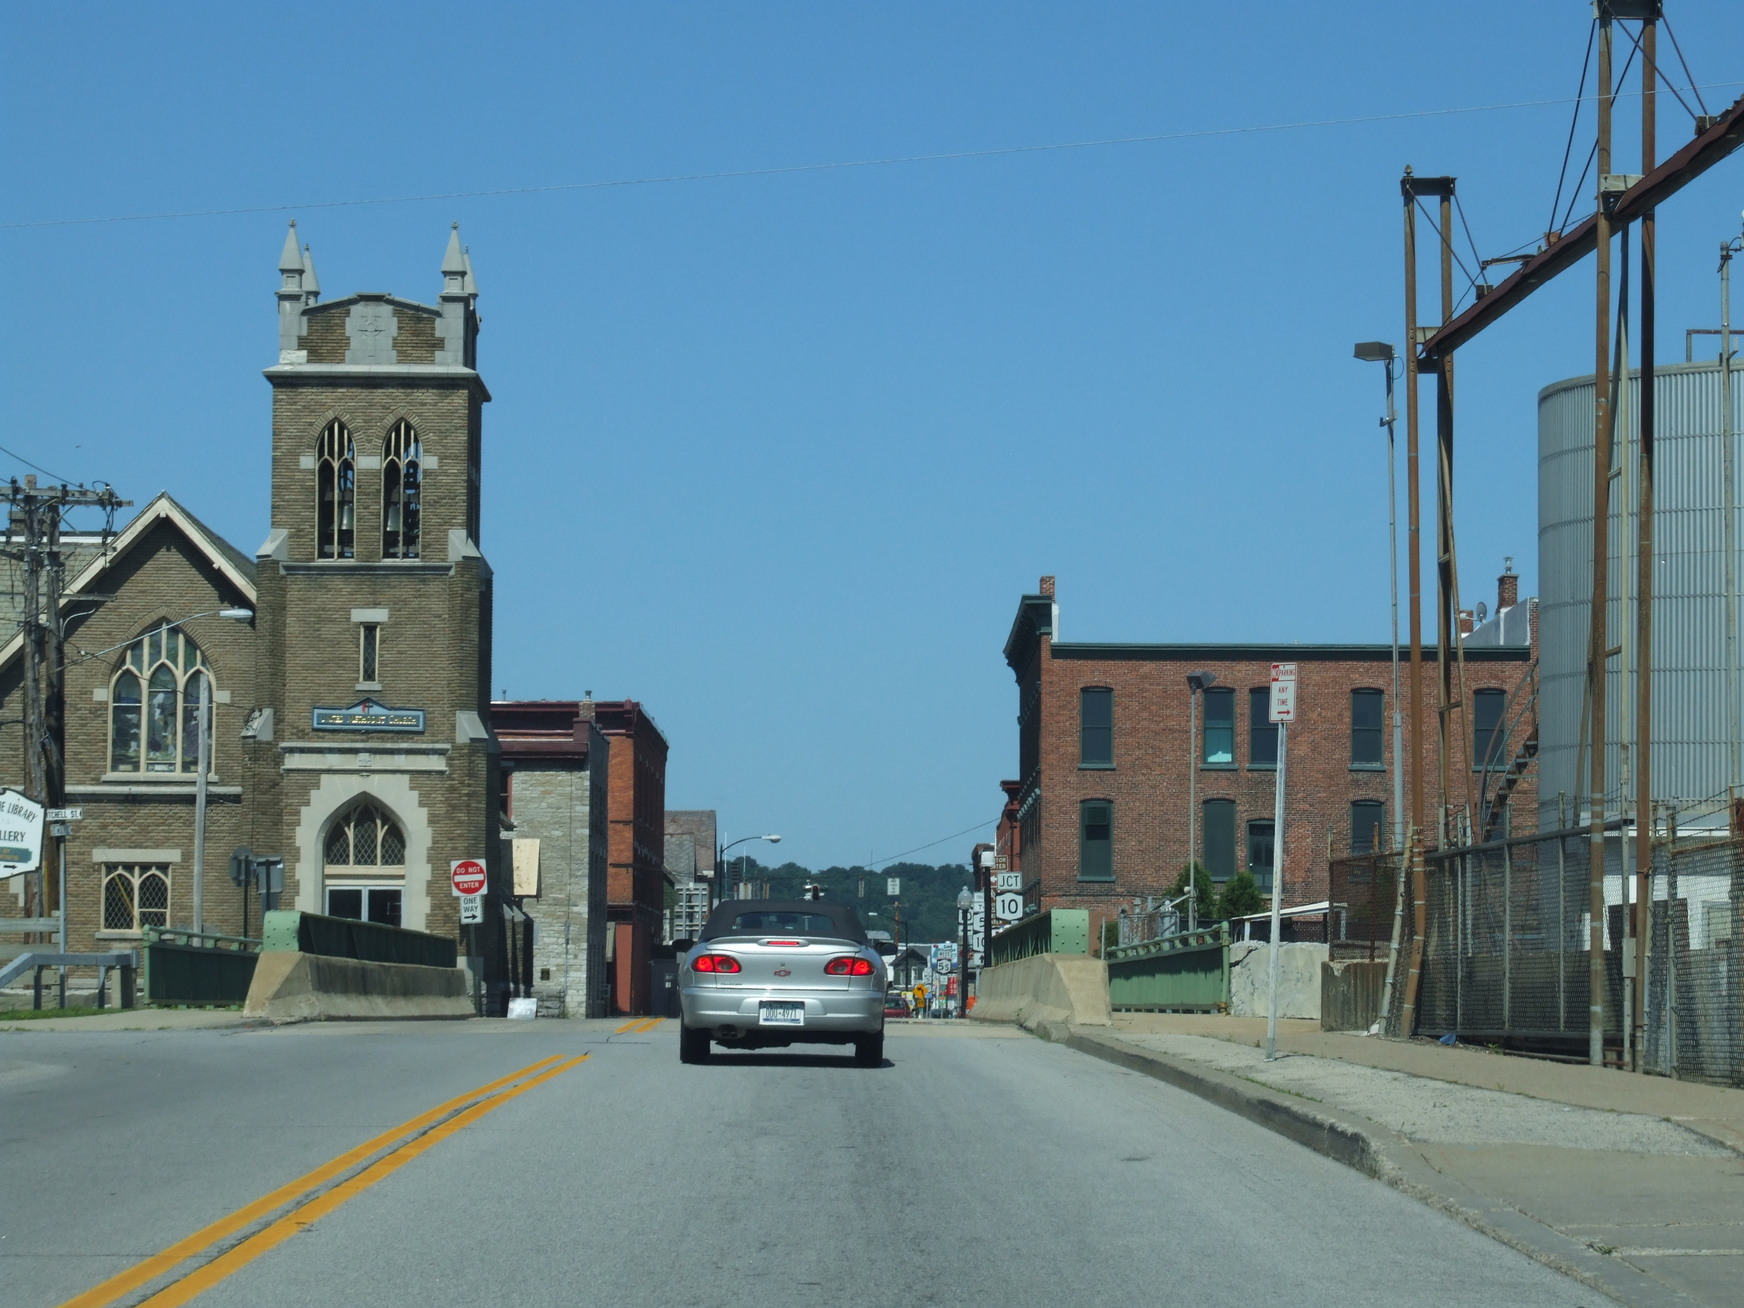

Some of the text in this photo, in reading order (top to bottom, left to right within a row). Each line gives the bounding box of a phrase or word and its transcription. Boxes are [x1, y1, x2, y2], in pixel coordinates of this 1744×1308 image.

[1277, 698, 1288, 706] TIME
[7, 802, 38, 823] LIBRARY
[459, 881, 480, 889] ENTER
[1000, 875, 1020, 888] JCT
[463, 896, 478, 905] ONE
[463, 905, 479, 913] WAY
[1001, 899, 1019, 915] 10
